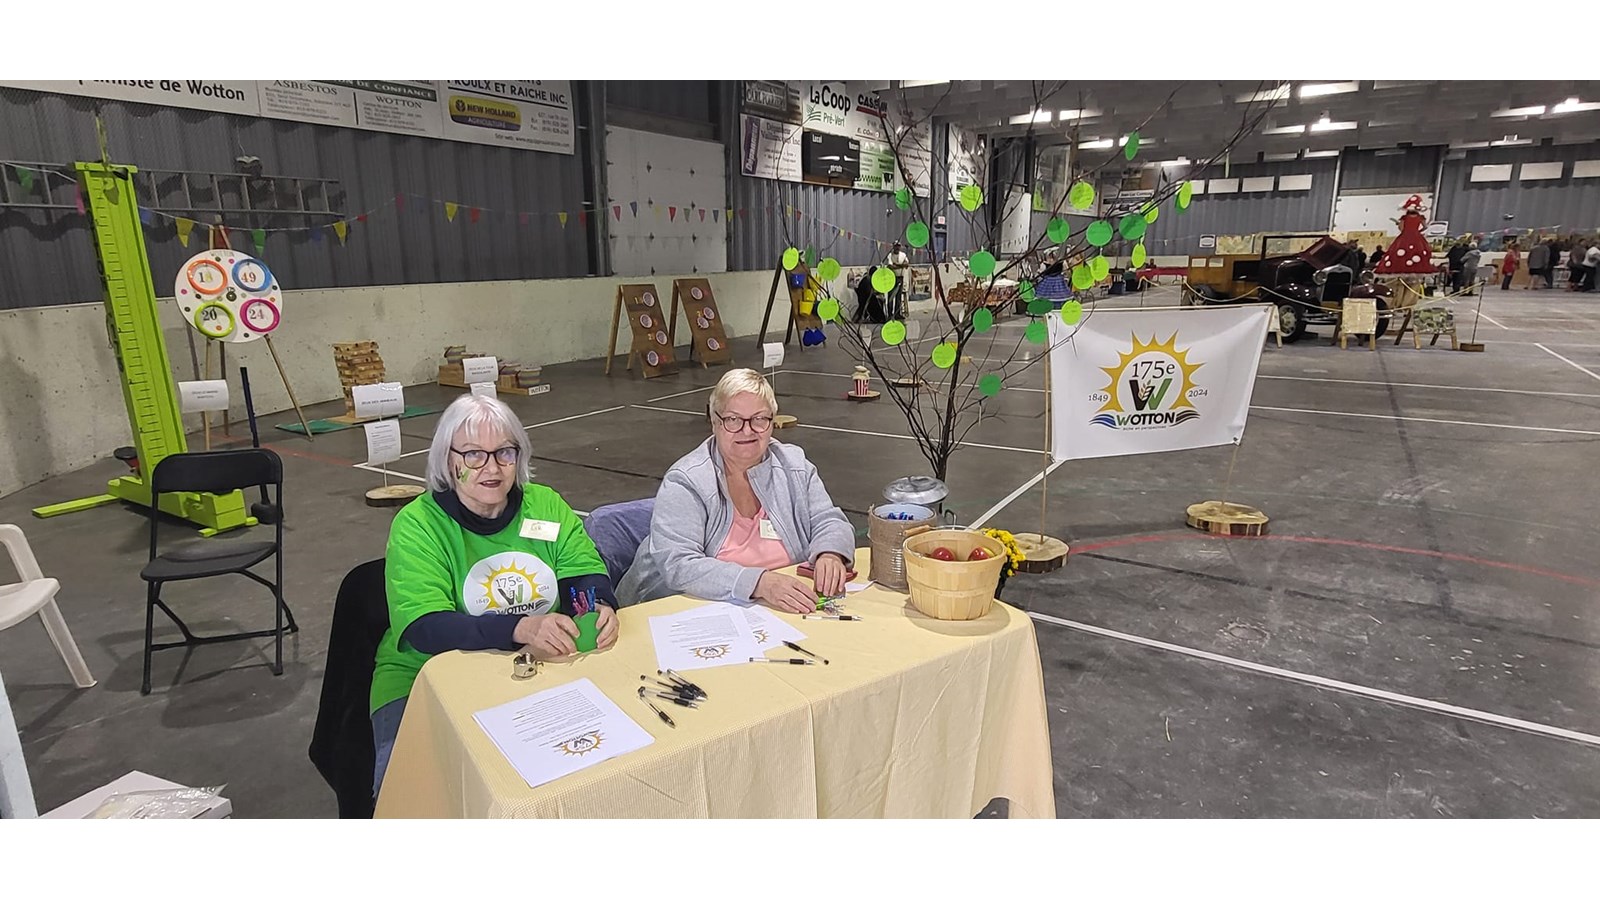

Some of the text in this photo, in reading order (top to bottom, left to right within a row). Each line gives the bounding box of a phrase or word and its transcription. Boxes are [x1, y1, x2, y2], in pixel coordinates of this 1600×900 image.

[160, 80, 181, 92] de
[186, 80, 245, 101] Wotton
[273, 80, 338, 95] ASBESTOS
[374, 83, 432, 98] CONFIANCE
[447, 80, 491, 91] ROULX
[494, 84, 506, 93] ET
[511, 85, 546, 100] RAICHE
[375, 95, 423, 109] WOTTON
[810, 85, 851, 116] La Coop
[467, 103, 516, 118] NEW HOLLAND
[241, 271, 257, 283] 49
[202, 308, 218, 321] 20
[249, 309, 264, 320] 24
[1131, 360, 1176, 379] 175e
[1088, 393, 1109, 402] 1849
[1188, 388, 1208, 398] 2024
[1115, 411, 1176, 426] WOTTON
[495, 575, 523, 588] 175e
[496, 602, 535, 615] WOTTON
